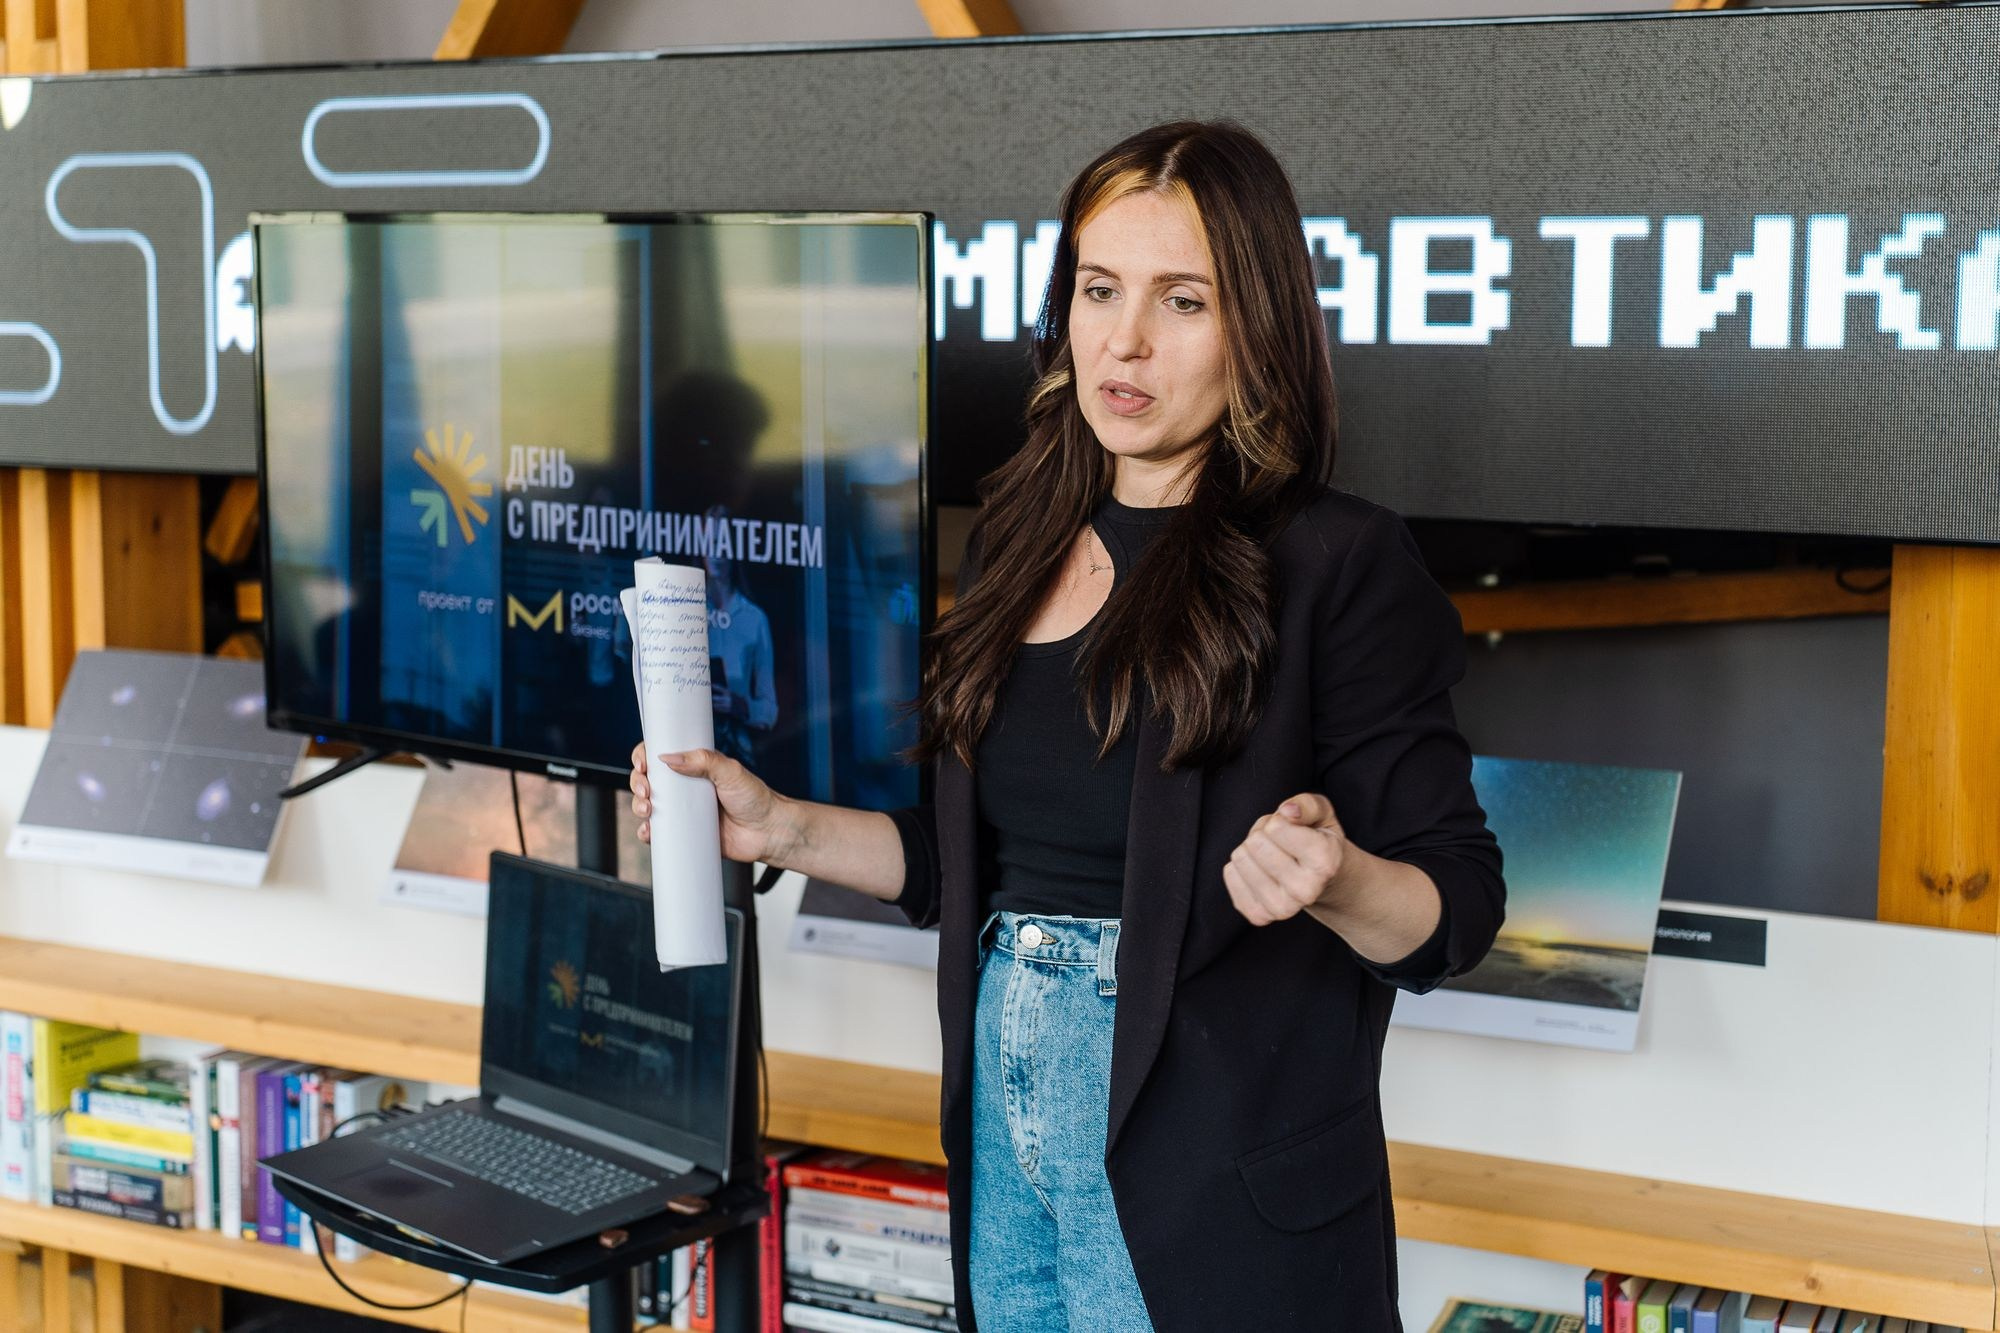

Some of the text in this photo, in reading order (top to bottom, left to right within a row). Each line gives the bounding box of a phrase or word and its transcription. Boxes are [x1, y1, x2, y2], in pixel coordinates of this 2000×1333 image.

[505, 445, 574, 491] ДЕНЬ
[507, 498, 824, 569] С ПРЕДПРИНИМАТЕЛЕМ
[418, 590, 495, 614] проект от
[1656, 927, 1712, 942] биология
